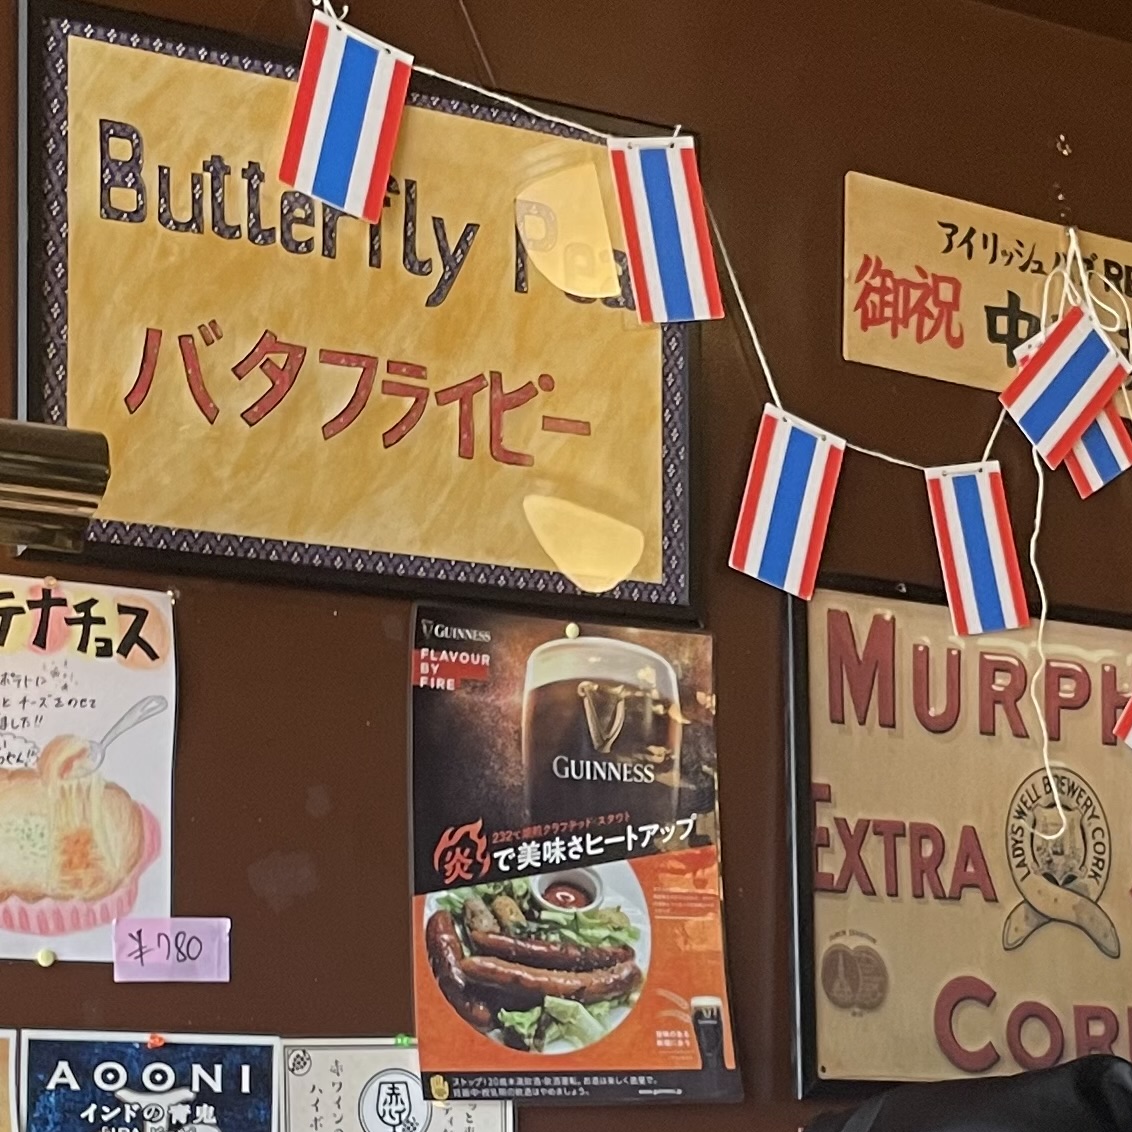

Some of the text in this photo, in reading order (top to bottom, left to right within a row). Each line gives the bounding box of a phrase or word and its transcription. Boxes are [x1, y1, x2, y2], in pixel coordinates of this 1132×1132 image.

[853, 253, 965, 349] 御祝
[124, 318, 591, 467] バタフライピー
[434, 623, 492, 643] GUINNESS
[420, 647, 491, 667] FLAVOUR
[420, 662, 440, 676] BY
[420, 676, 456, 691] FIRE
[552, 754, 655, 784] GUINNESS
[811, 782, 999, 904] EXTRA
[1087, 826, 1106, 886] CORK
[127, 929, 203, 966] ¥780
[46, 1060, 251, 1094] AOONI
